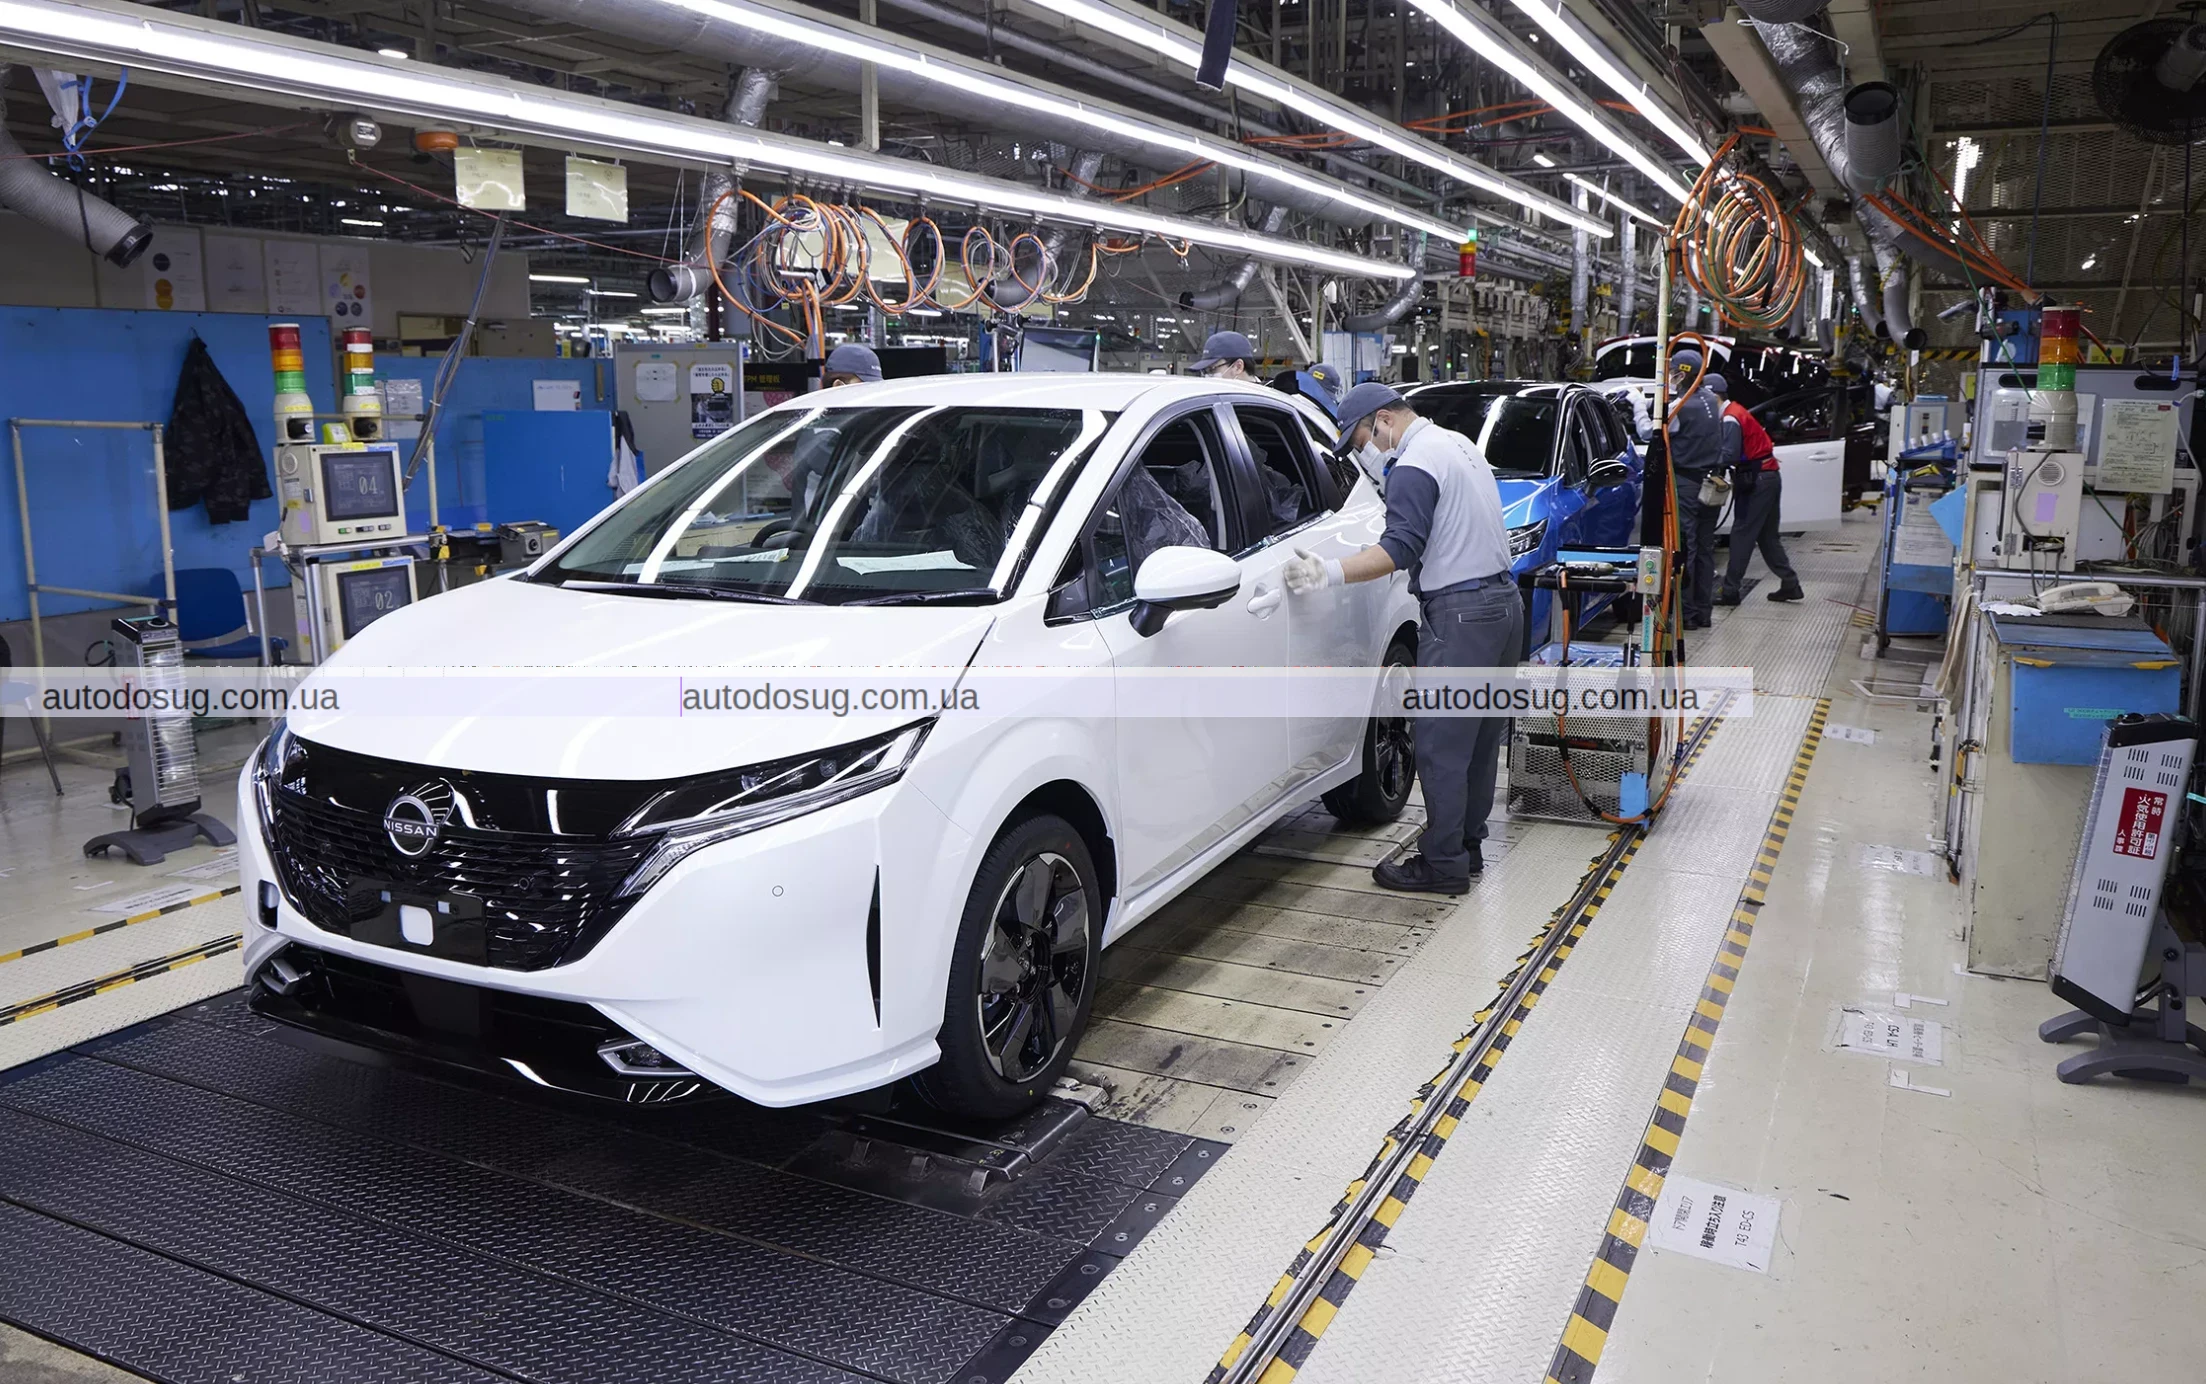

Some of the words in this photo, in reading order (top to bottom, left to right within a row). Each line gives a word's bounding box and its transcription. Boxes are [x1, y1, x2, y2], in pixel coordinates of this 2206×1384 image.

[358, 476, 378, 495] 04
[375, 591, 394, 611] 02
[2151, 796, 2165, 817] 常時
[384, 819, 438, 837] NISSAN
[2127, 795, 2151, 855] 火気使用許可証
[1699, 1194, 1727, 1249] 稼働時立ち入り注意
[1734, 1232, 1748, 1247] T43
[1741, 1209, 1755, 1232] ED-CS
